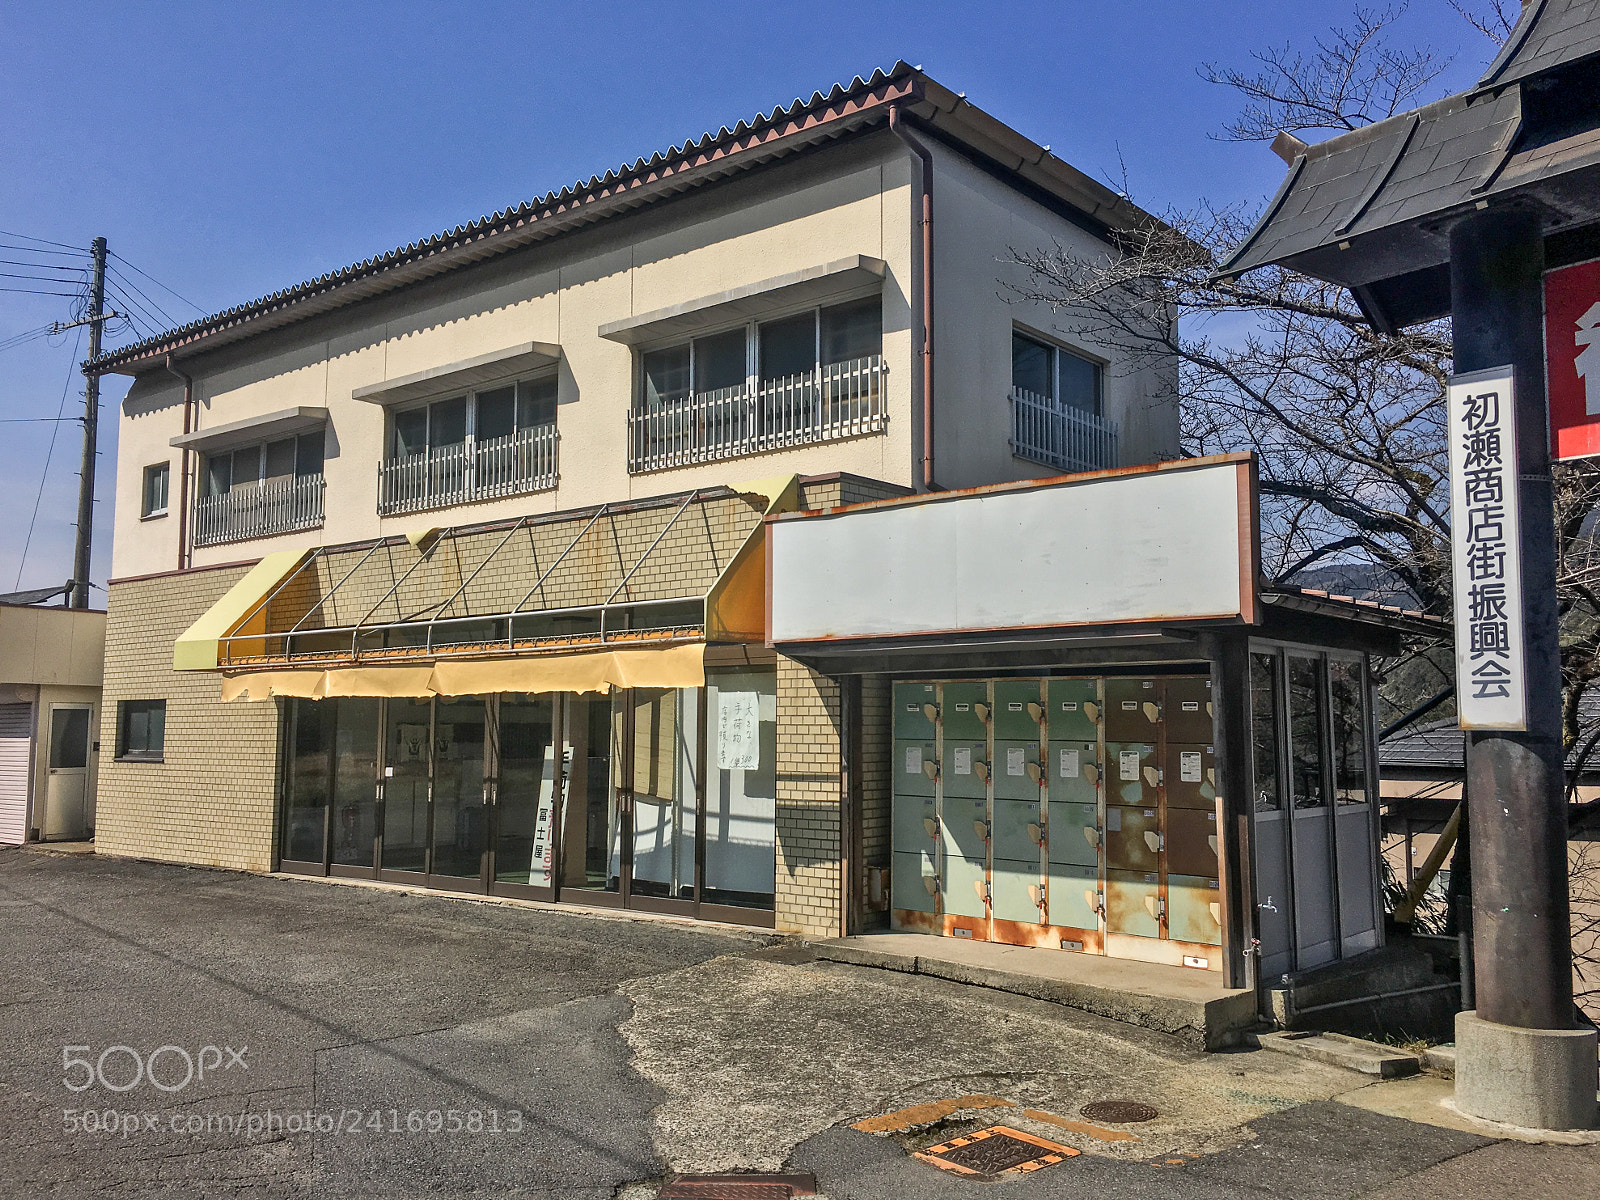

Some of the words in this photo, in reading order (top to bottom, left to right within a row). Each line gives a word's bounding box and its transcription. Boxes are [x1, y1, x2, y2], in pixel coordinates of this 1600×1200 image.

[1461, 391, 1511, 699] 初瀬商店街振興会
